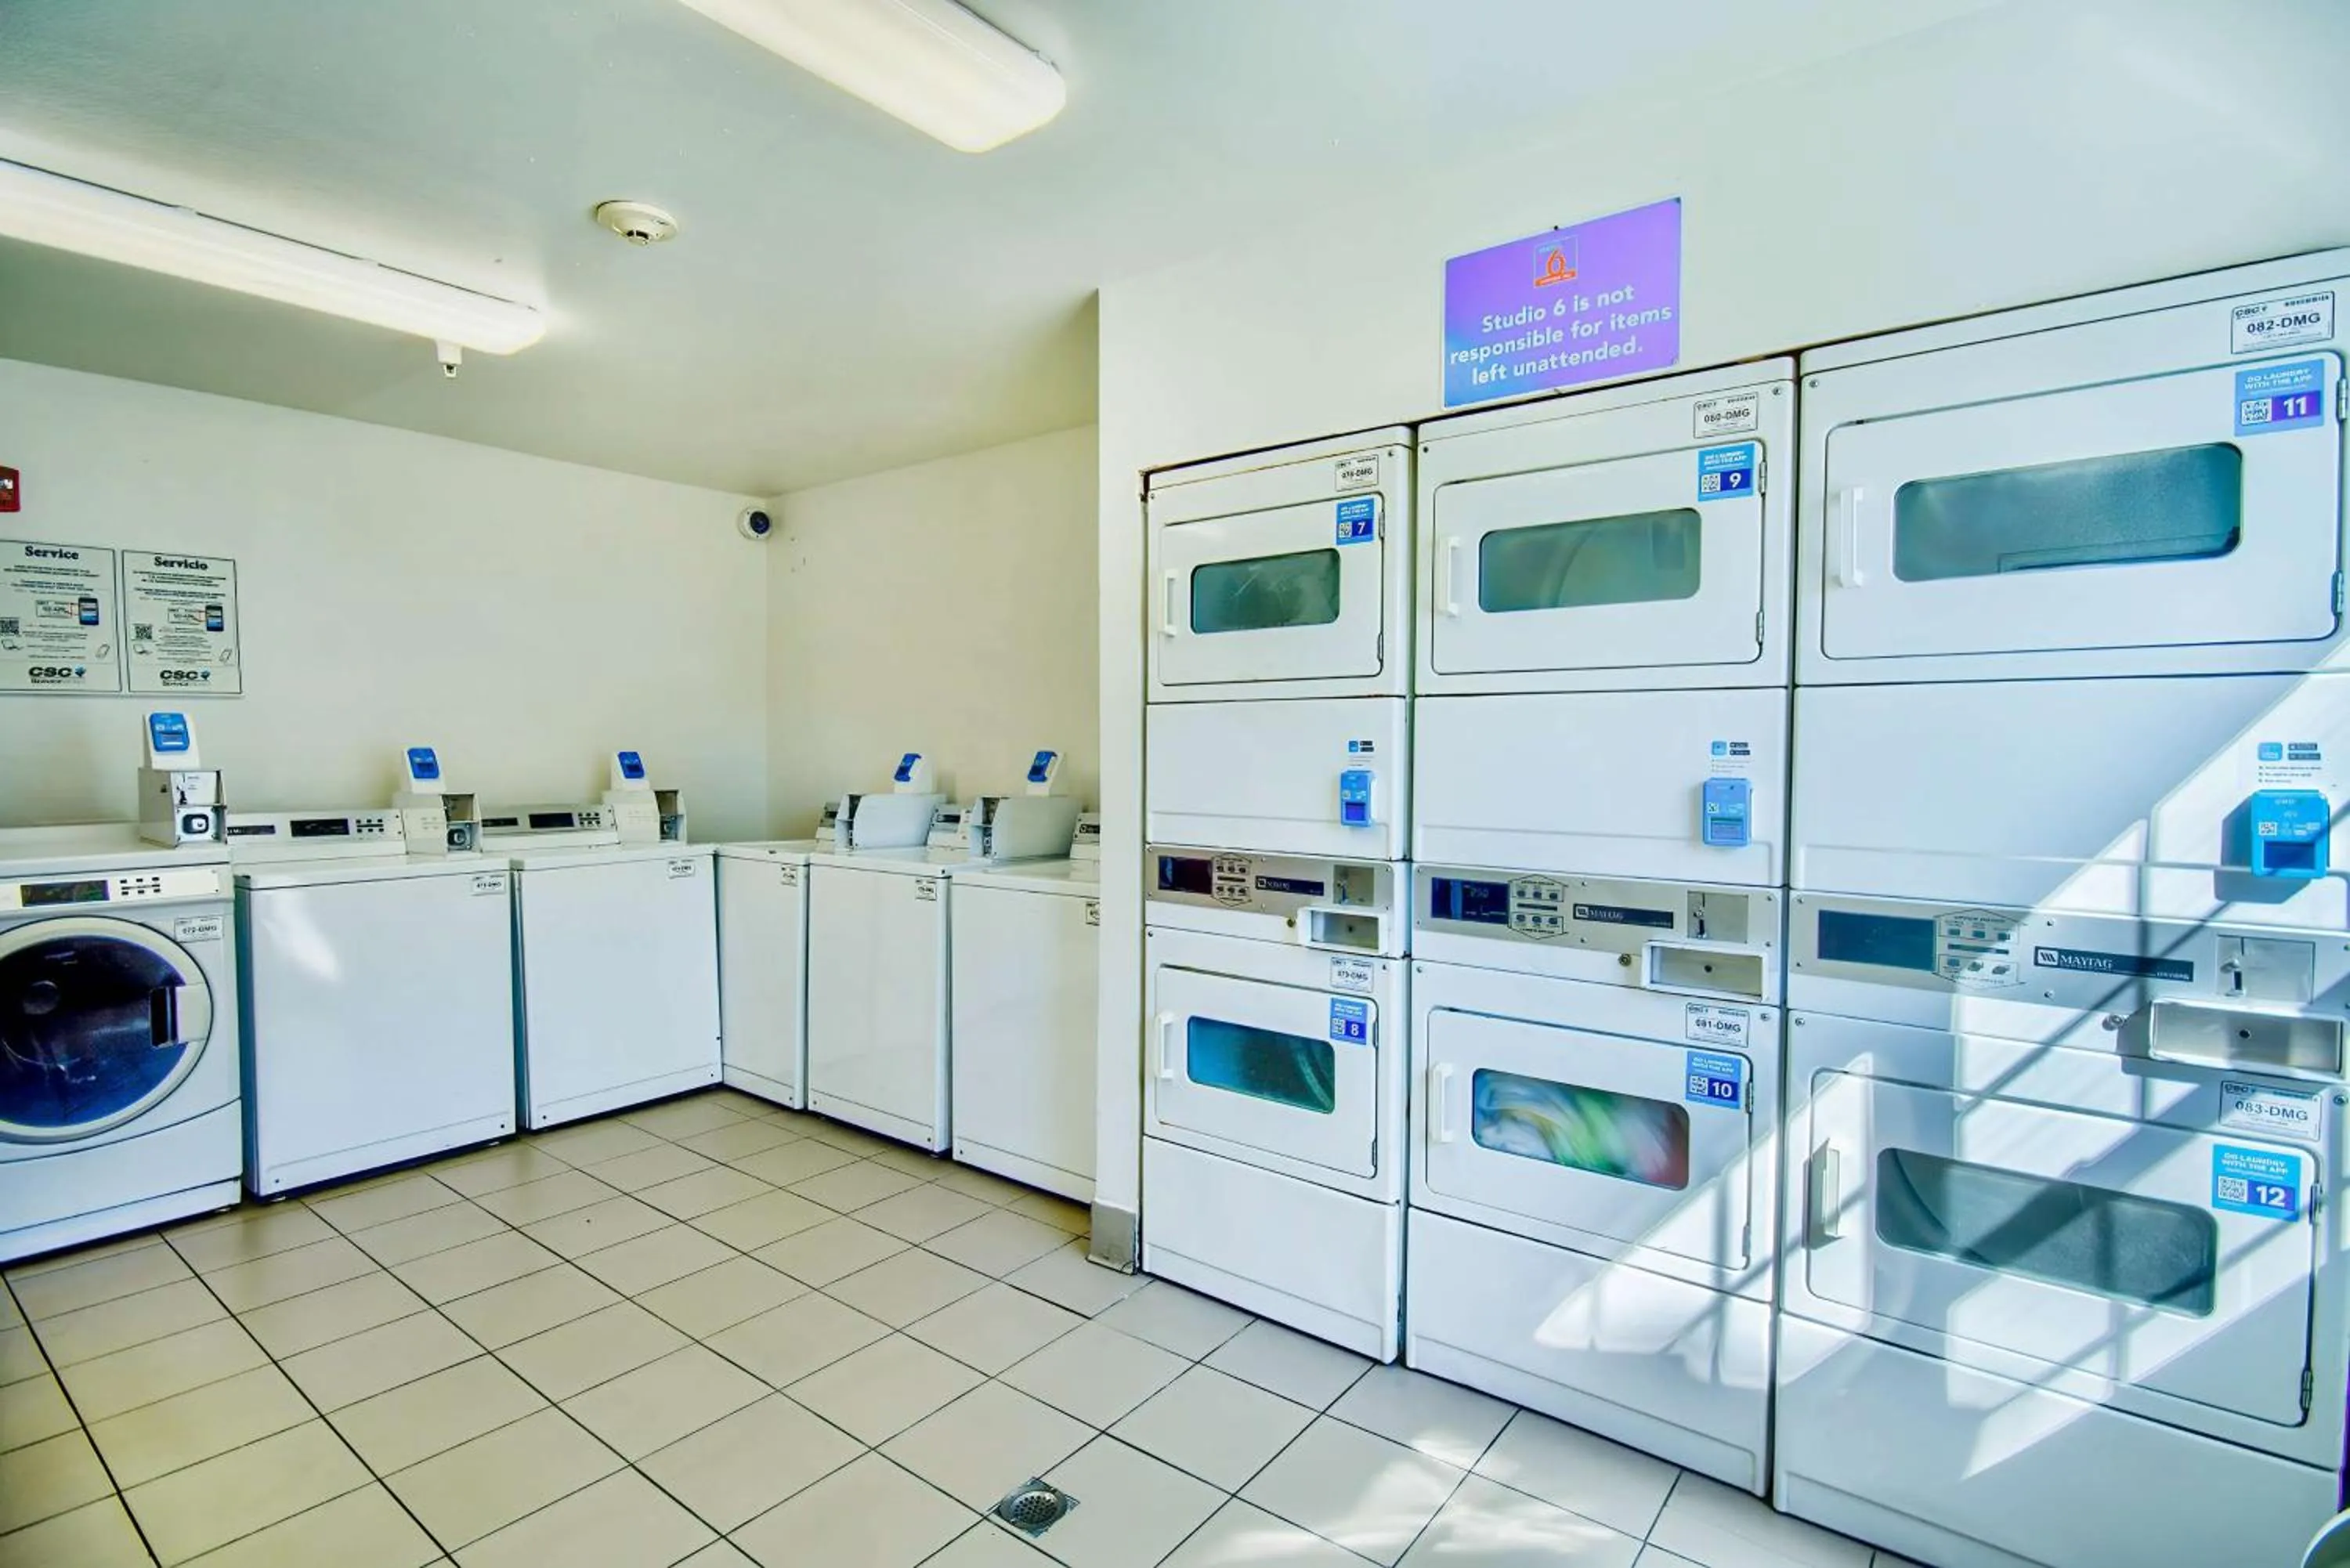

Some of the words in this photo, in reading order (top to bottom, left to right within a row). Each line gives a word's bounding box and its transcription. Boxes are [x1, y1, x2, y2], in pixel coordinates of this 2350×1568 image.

[1482, 305, 1546, 333] Studio
[1553, 299, 1566, 316] 6
[1574, 295, 1589, 313] is
[1597, 285, 1635, 307] not
[2247, 313, 2321, 333] 082-DMG
[1450, 327, 1564, 365] responsible
[1571, 319, 1603, 340] for
[1610, 306, 1672, 332] items
[1472, 363, 1507, 385] left
[1513, 337, 1643, 376] unattended.
[2283, 396, 2307, 417] 11
[1729, 472, 1742, 489] 9
[1357, 522, 1366, 535] 7
[24, 545, 79, 560] Service
[154, 555, 208, 571] Servicio
[28, 666, 72, 678] CSC
[160, 669, 199, 681] CSC
[2059, 954, 2113, 970] MAYTAG
[1350, 1023, 1360, 1036] 8
[1712, 1082, 1733, 1098] 10
[2235, 1100, 2308, 1121] 083-DMG
[2256, 1185, 2286, 1208] 12
